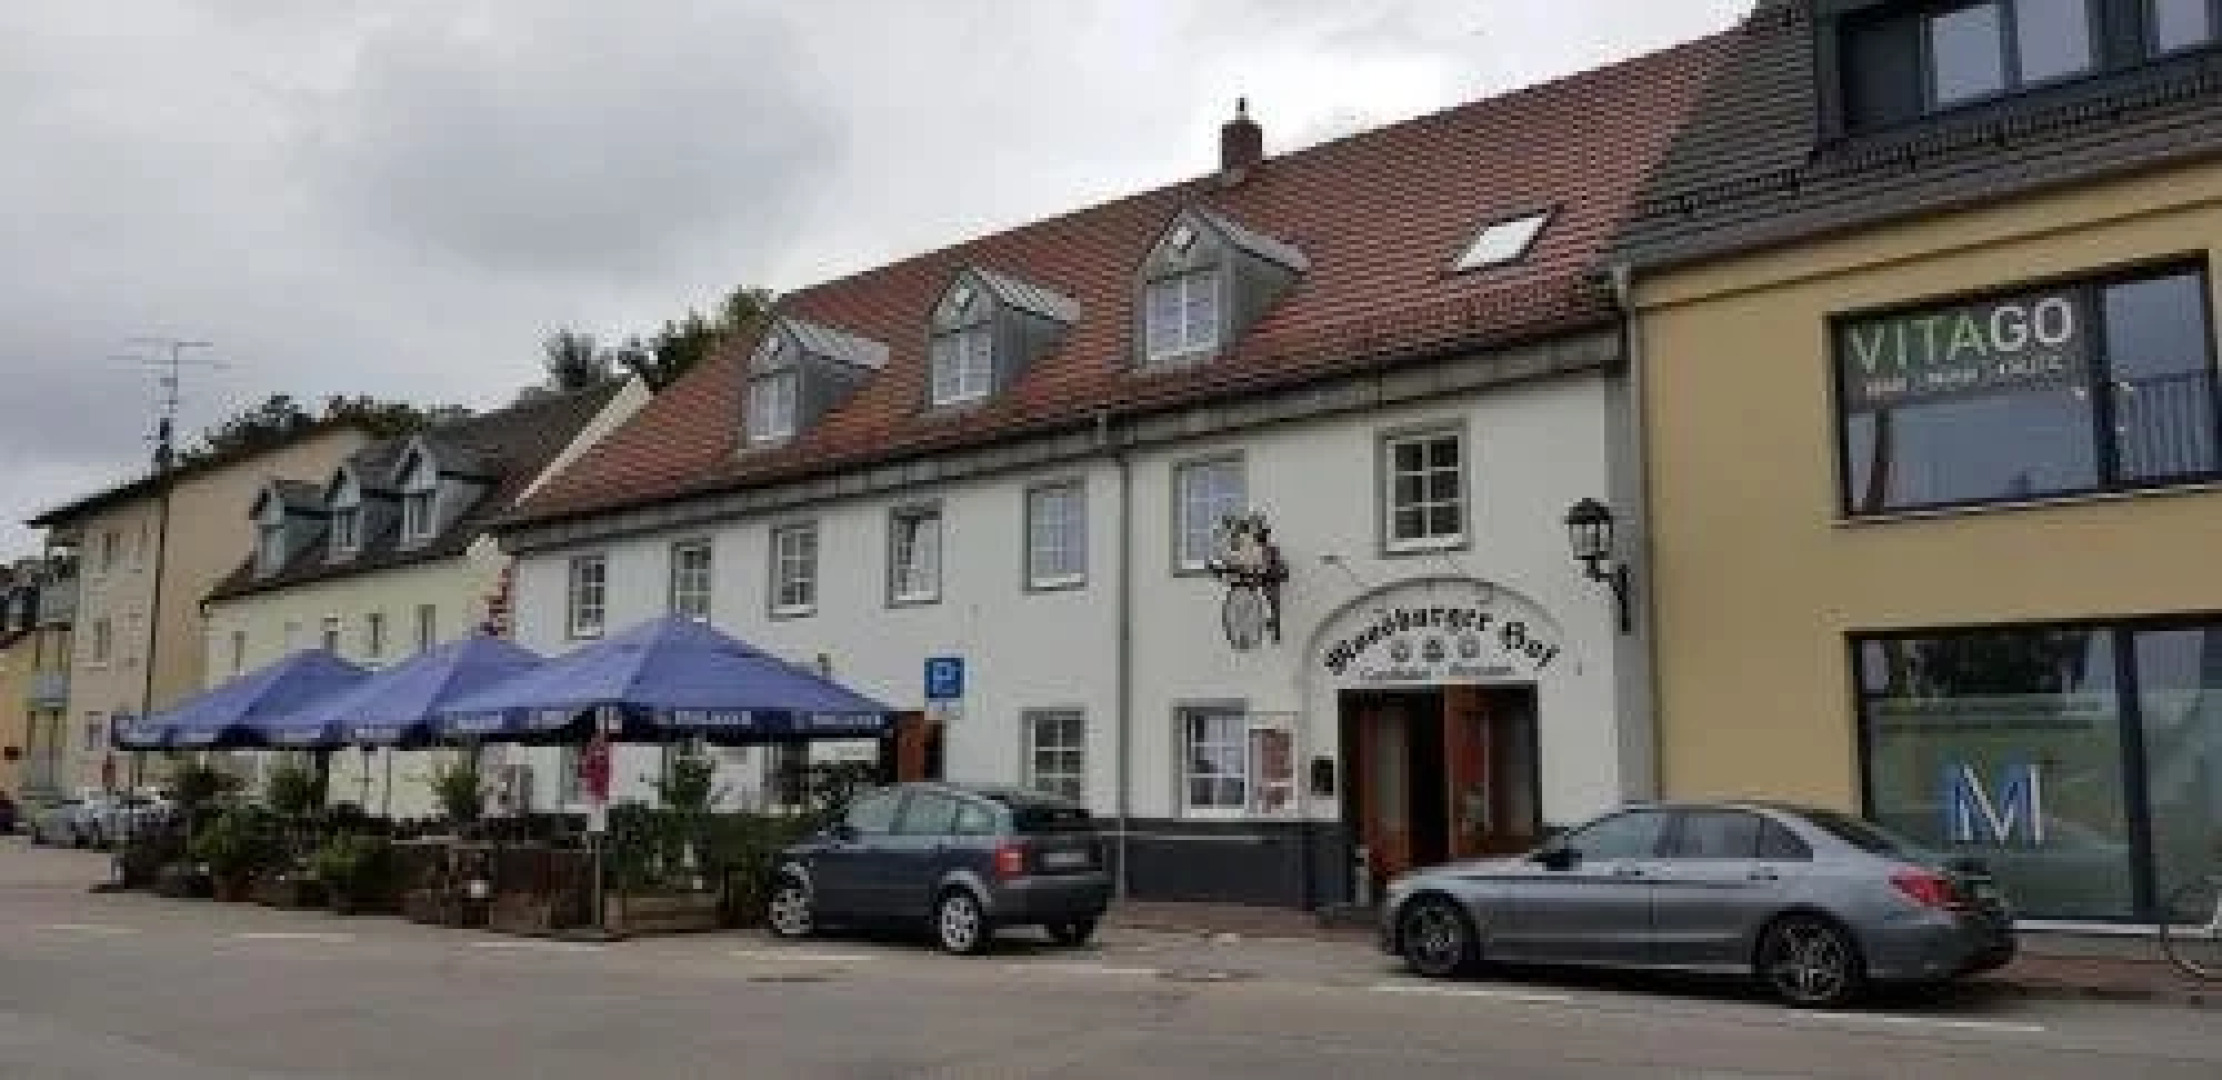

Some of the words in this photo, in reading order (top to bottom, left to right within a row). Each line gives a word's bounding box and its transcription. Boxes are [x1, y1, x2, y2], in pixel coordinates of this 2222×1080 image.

[1851, 297, 2073, 373] VITAGO
[1502, 620, 1561, 669] Hof
[932, 661, 956, 695] P
[1953, 762, 2043, 846] M
